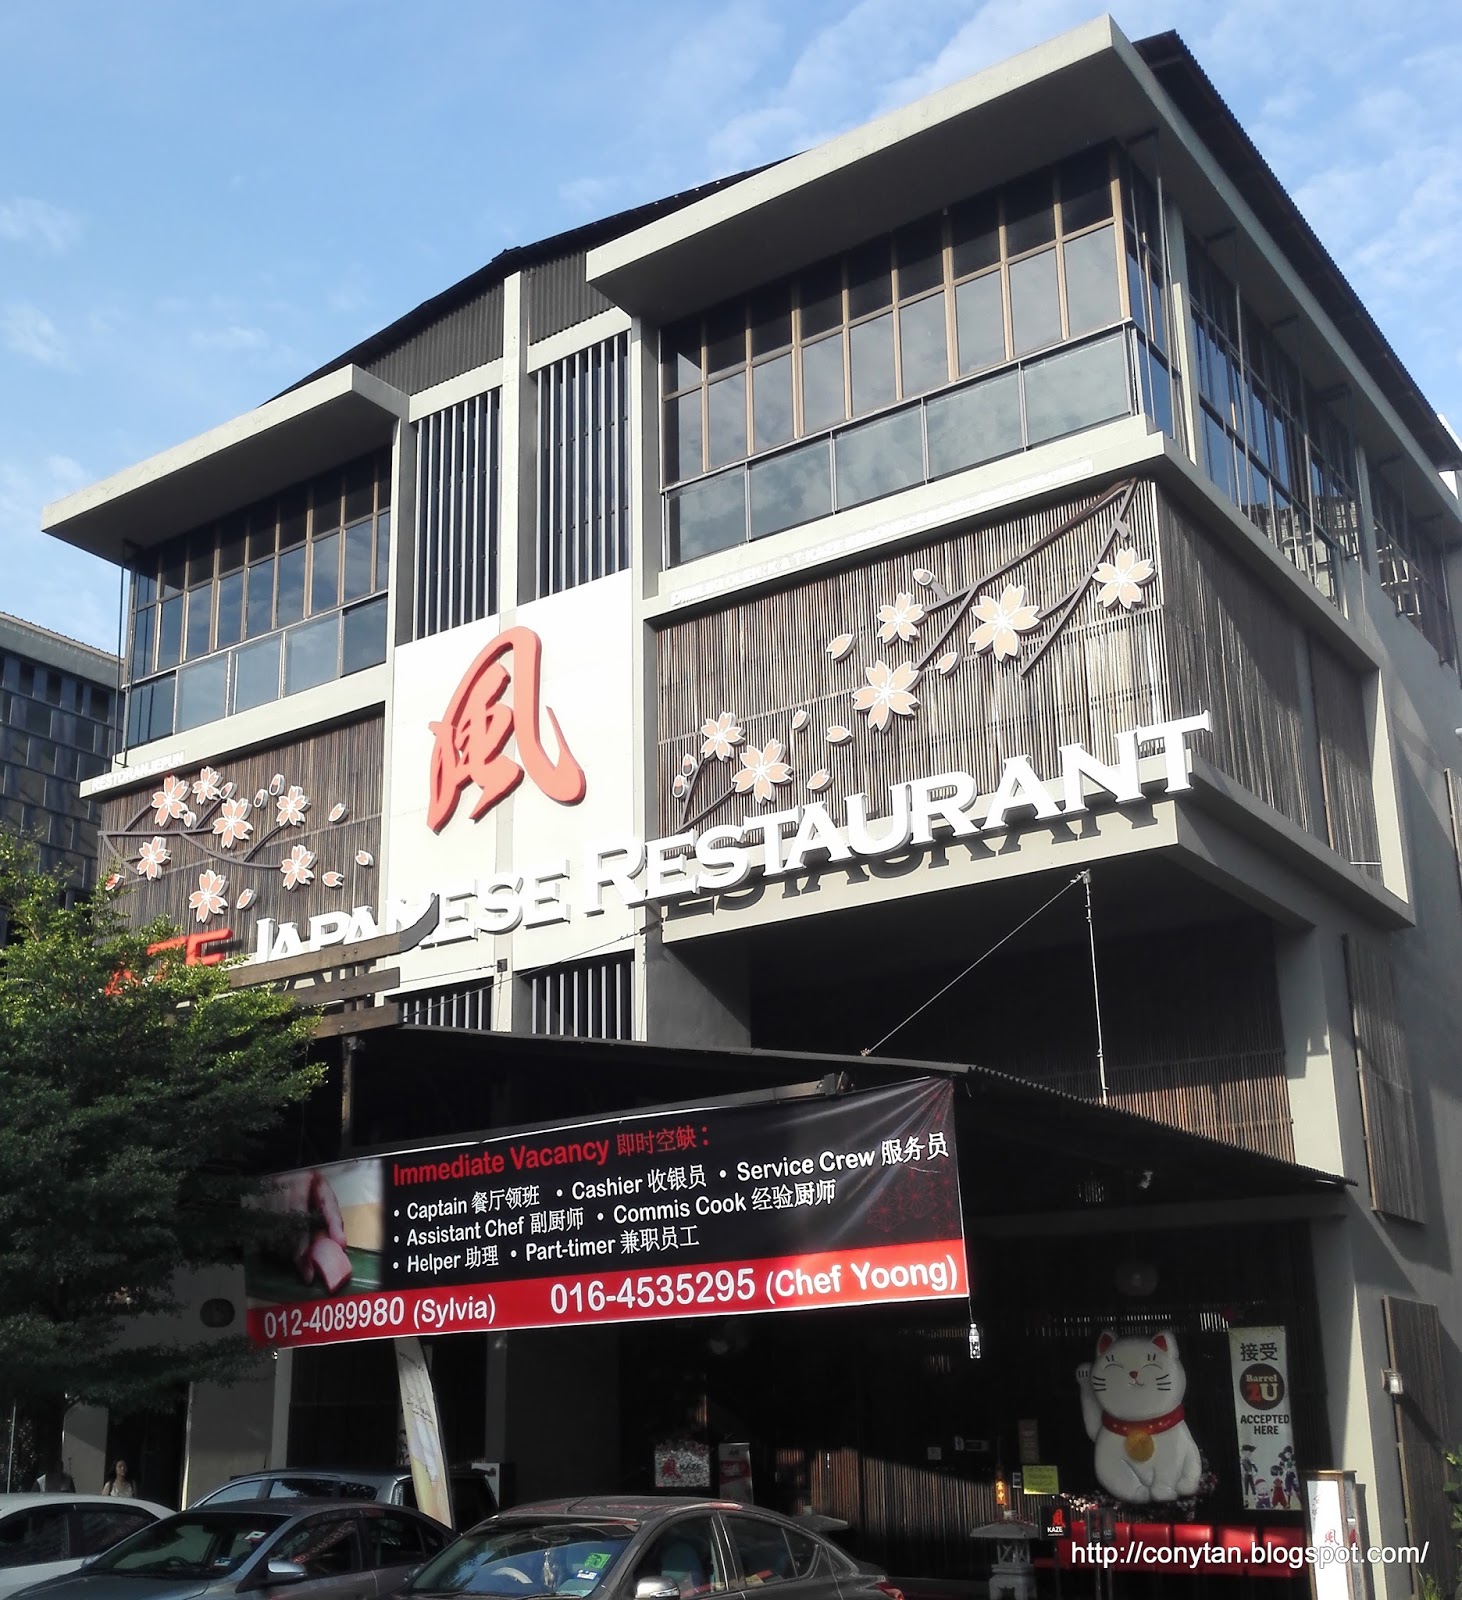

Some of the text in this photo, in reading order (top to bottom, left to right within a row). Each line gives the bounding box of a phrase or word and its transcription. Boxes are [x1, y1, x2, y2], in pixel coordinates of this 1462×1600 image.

[255, 856, 571, 964] JAPANESE
[583, 711, 1211, 918] RESTAURANT
[394, 1152, 504, 1187] Immediate
[511, 1139, 609, 1170] Vacancy
[406, 1132, 950, 1222] Captain 餐厅领班 Cashier 收银员 Service Crew 服务员
[406, 1179, 836, 1247] Assistant Chef 副厨师 Commis Cook 经验厨师
[407, 1225, 700, 1277] Helper 助理 Part-timer 兼职员工
[550, 1255, 958, 1314] 016-4535295 (Chef Yoong)
[264, 1294, 496, 1339] 012-4089980 (Sylvia)
[1239, 1342, 1278, 1362] 接受
[1245, 1373, 1278, 1383] Barrel
[1240, 1414, 1290, 1425] ACCEPTED
[1253, 1425, 1279, 1435] HERE
[1047, 1525, 1063, 1533] KAZE
